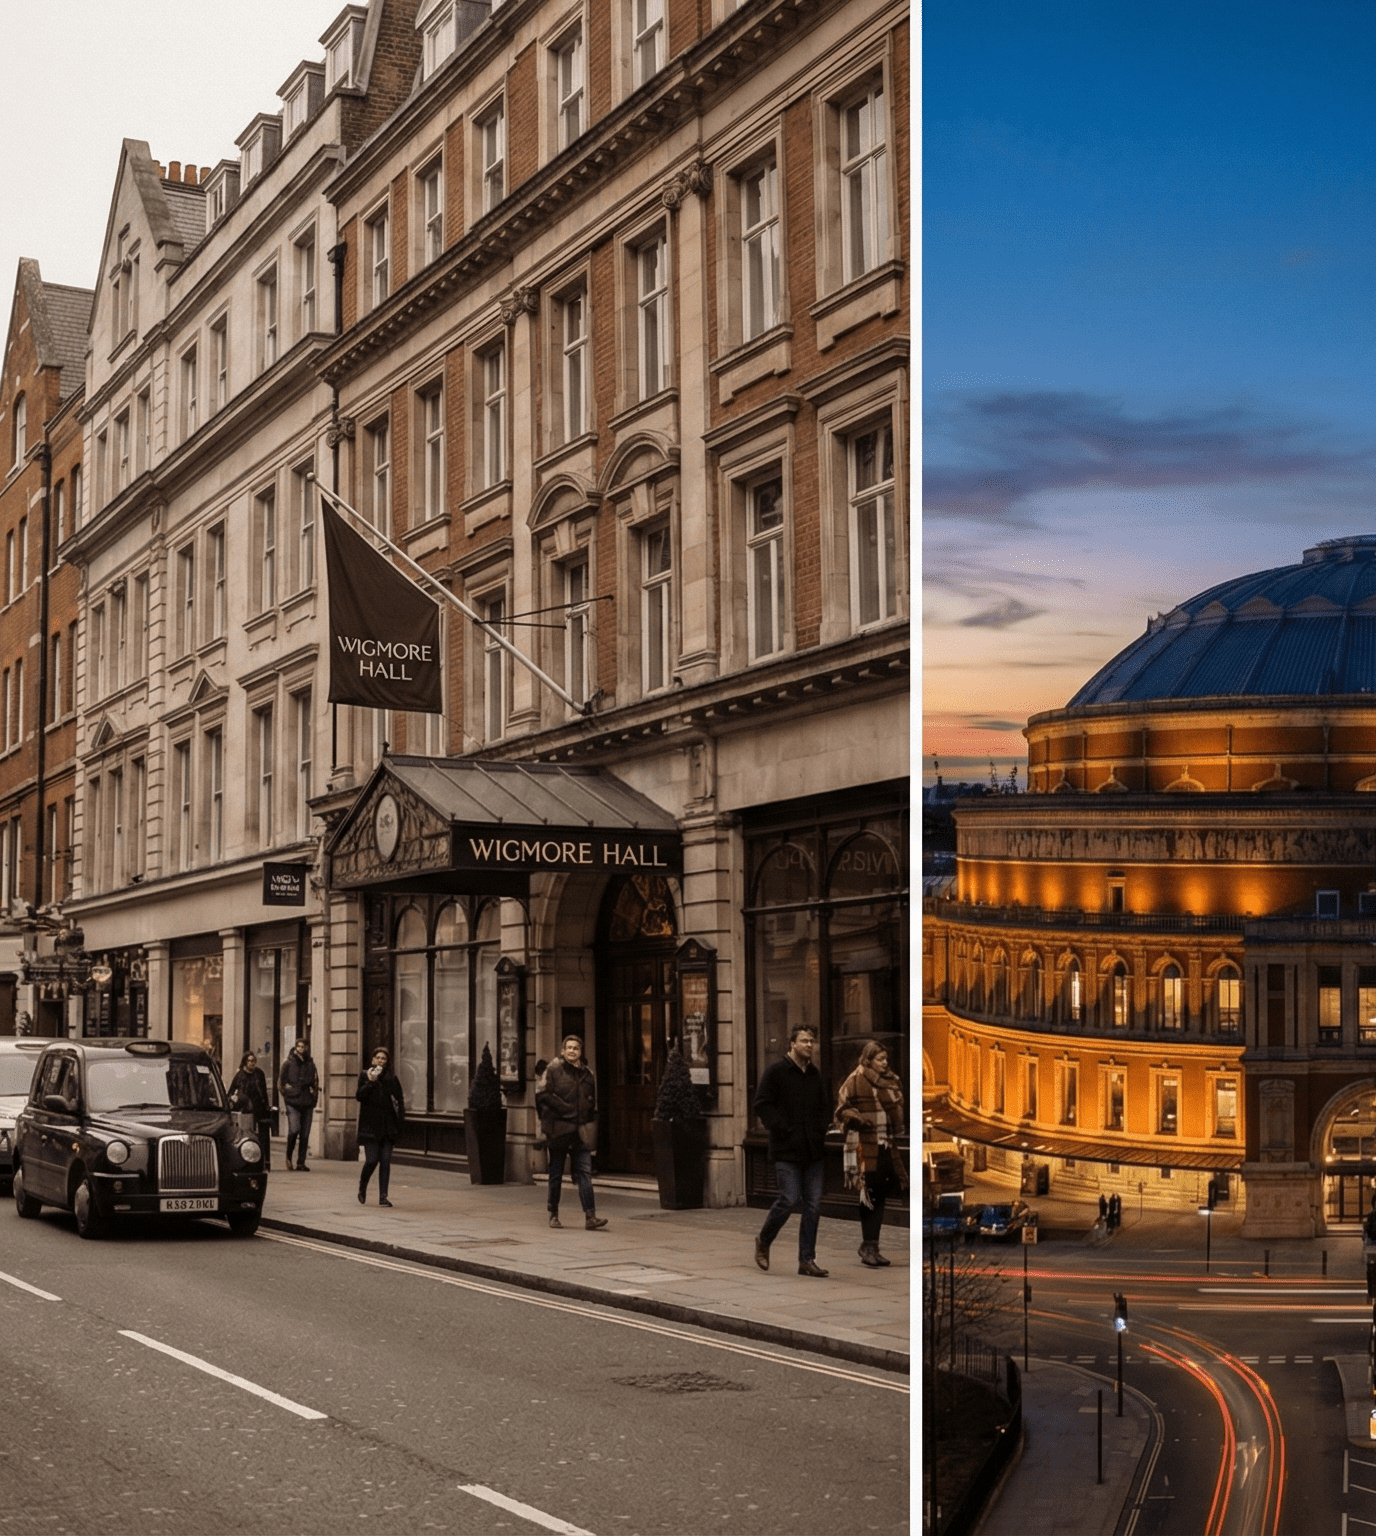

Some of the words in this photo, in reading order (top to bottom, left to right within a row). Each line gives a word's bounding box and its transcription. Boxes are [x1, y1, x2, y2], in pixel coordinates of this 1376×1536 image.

[337, 635, 432, 662] WIGMORE
[360, 660, 412, 681] HALL
[469, 838, 593, 864] WIGMORE
[603, 843, 668, 867] HALL
